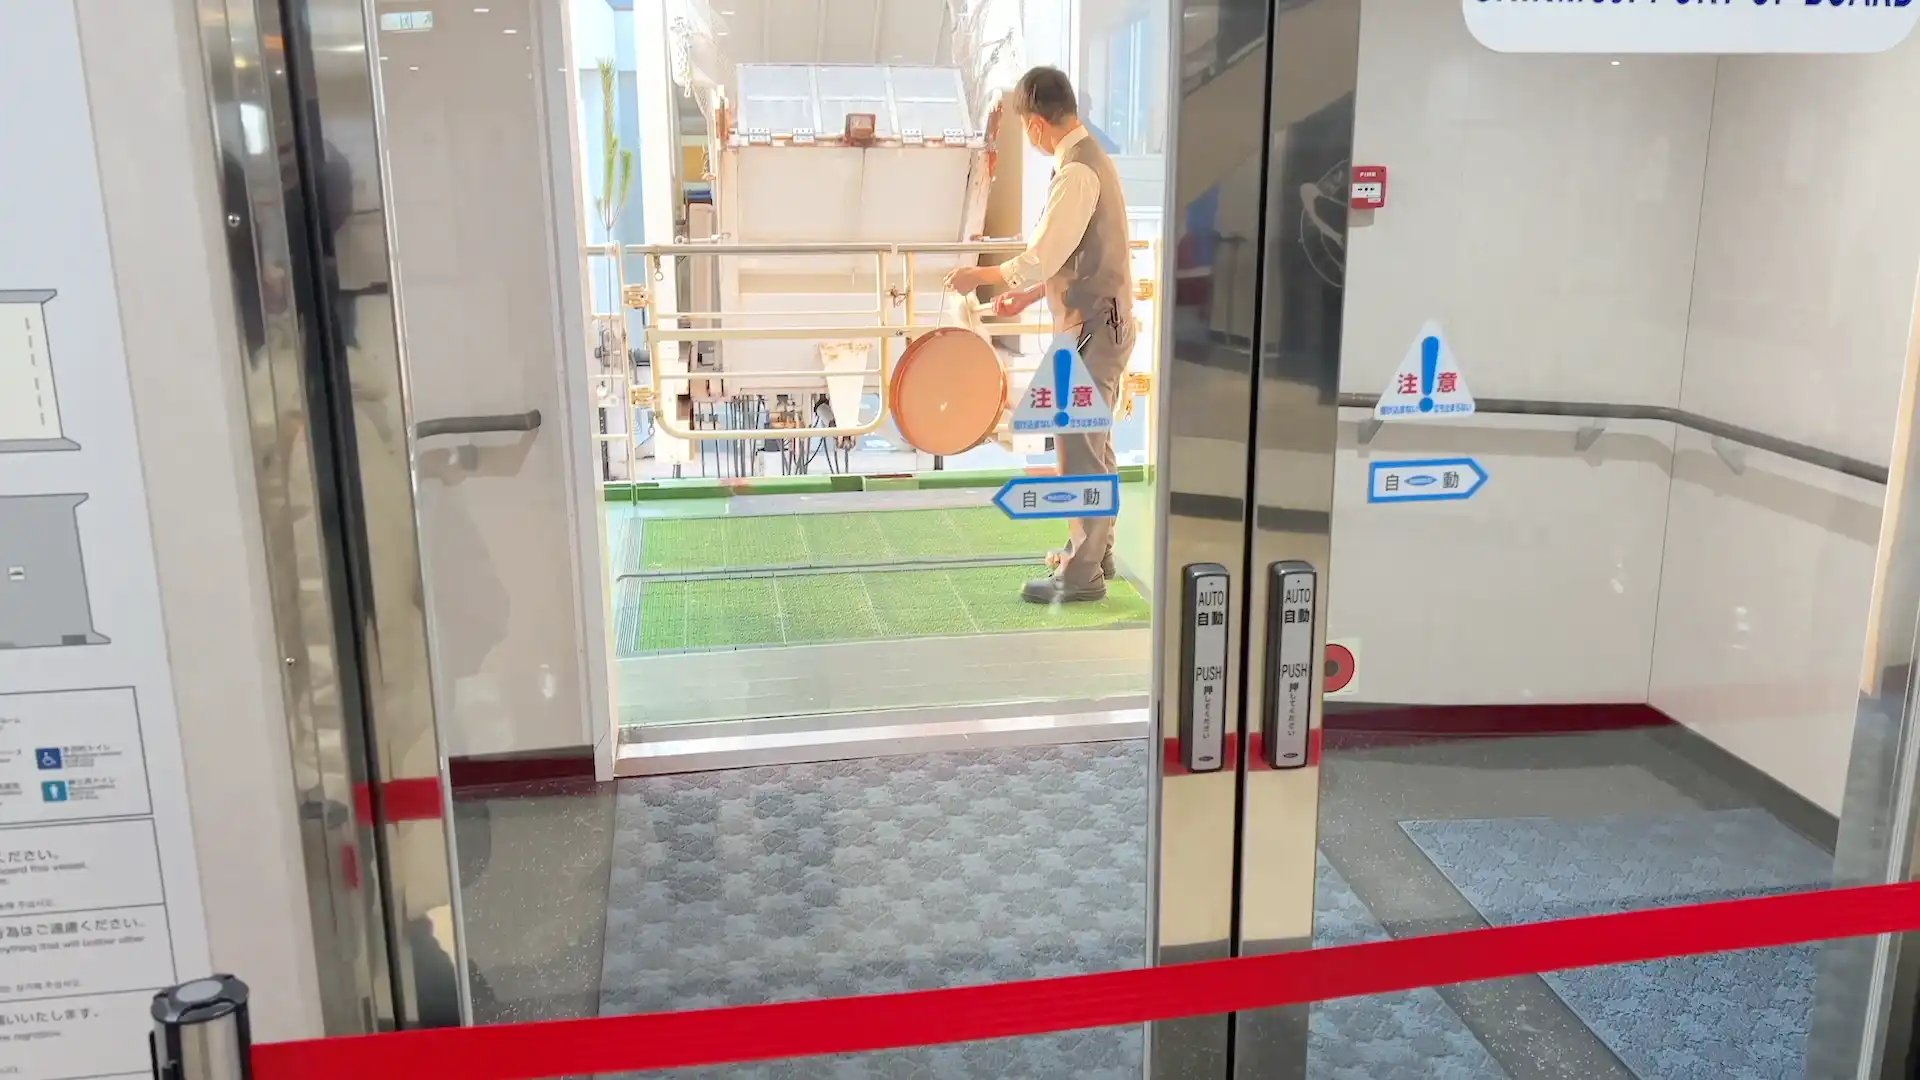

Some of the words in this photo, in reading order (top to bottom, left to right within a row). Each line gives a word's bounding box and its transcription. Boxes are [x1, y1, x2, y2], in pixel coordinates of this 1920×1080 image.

[1396, 373, 1418, 395] 注
[1436, 372, 1458, 393] 意
[1030, 387, 1052, 409] 注
[1071, 386, 1093, 407] 意
[1198, 590, 1224, 606] AUTO
[1284, 588, 1311, 604] AUTO
[1197, 611, 1223, 627] 自動
[1284, 608, 1310, 624] 自動
[1196, 666, 1222, 682] PUSH
[1281, 663, 1308, 679] PUSH
[0, 918, 147, 939] 為はご遠慮ください。
